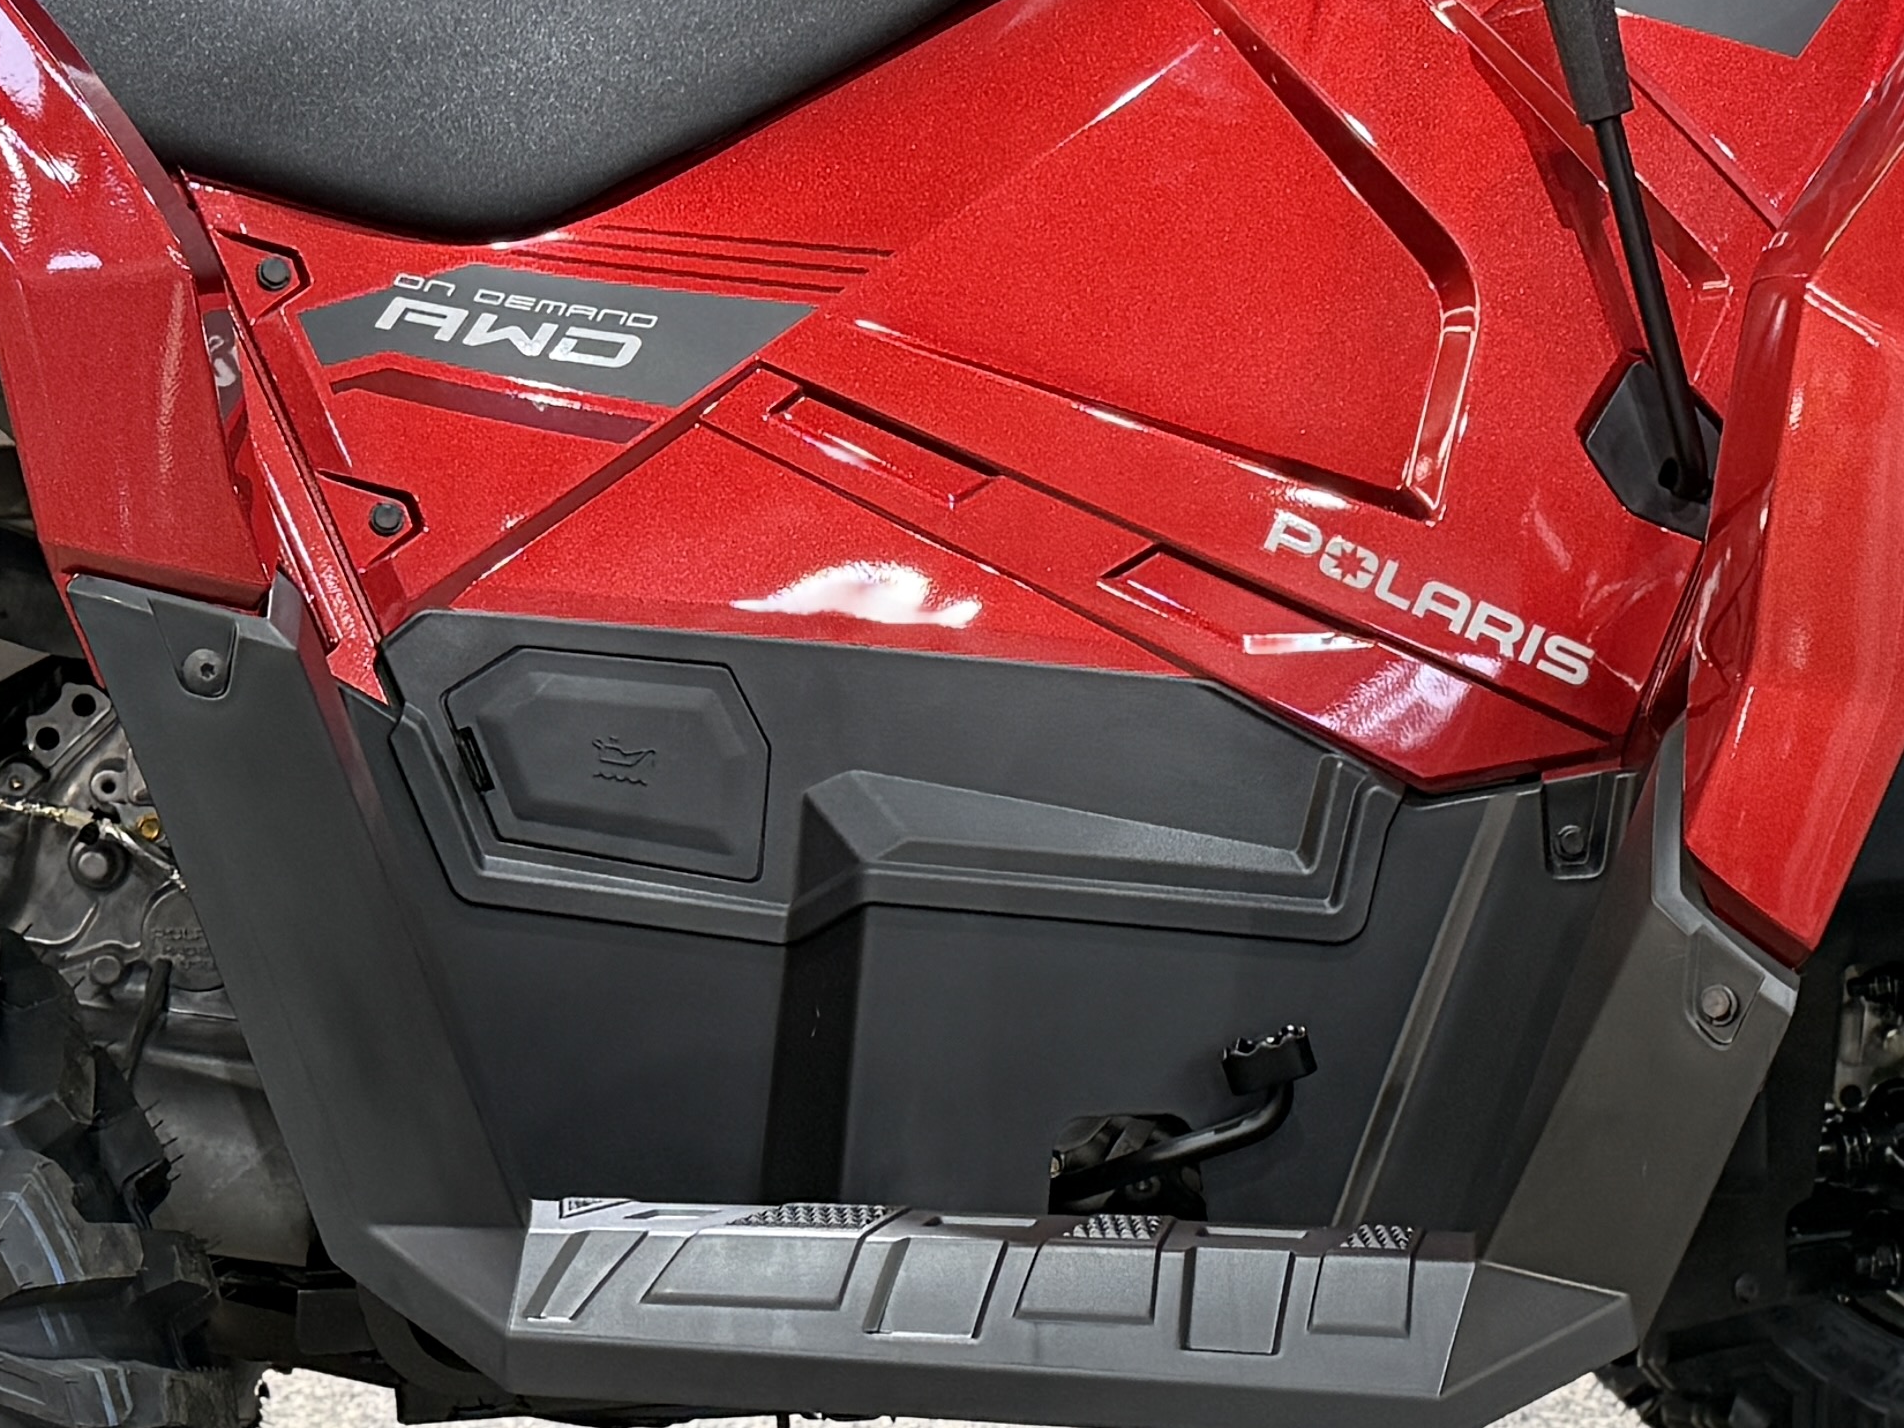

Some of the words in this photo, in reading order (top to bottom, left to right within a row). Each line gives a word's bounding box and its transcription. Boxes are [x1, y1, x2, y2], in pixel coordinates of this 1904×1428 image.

[373, 296, 643, 369] AWD
[392, 272, 456, 298] ON
[473, 287, 659, 330] DEMAND
[1262, 507, 1597, 687] POLARIS
